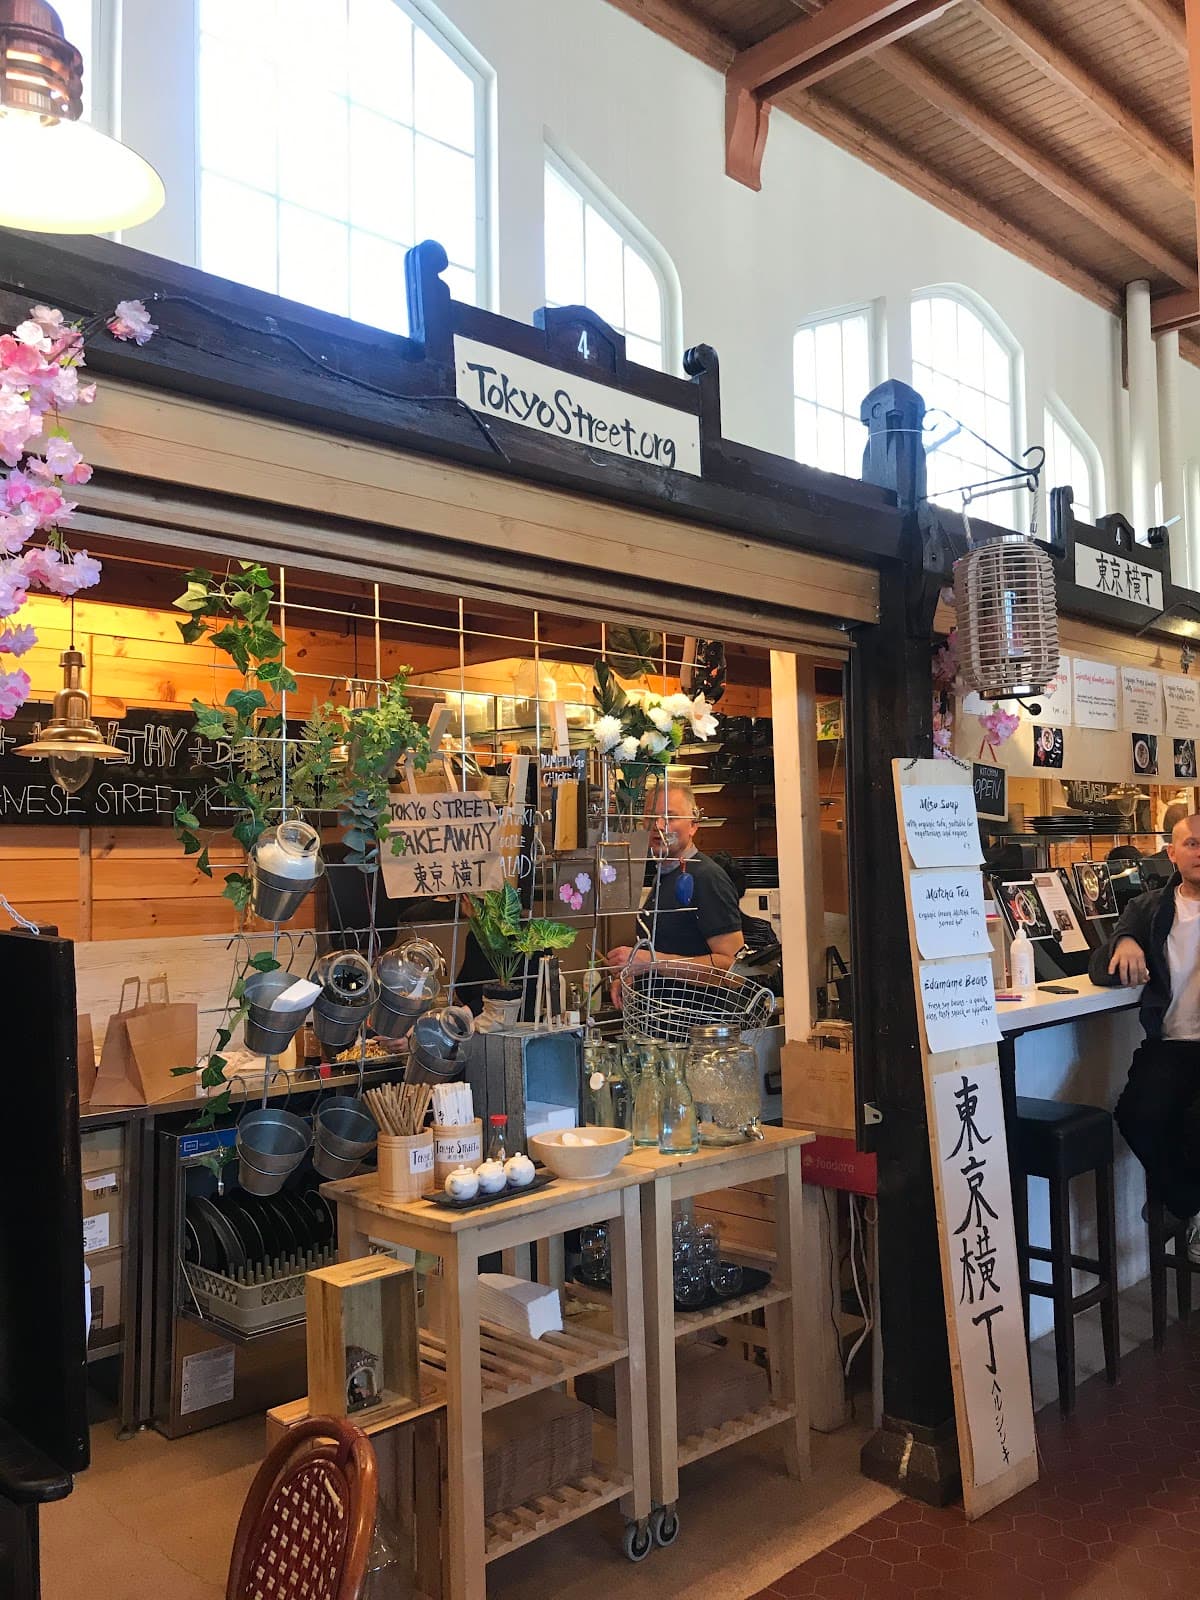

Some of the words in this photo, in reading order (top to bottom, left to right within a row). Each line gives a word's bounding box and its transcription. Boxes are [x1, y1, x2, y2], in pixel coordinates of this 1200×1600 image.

[577, 330, 590, 360] 4
[466, 361, 676, 468] TokyoStreet.org
[1096, 552, 1153, 605] 東京横丁
[96, 783, 192, 815] STREET
[975, 778, 1001, 800] OPEN
[432, 799, 493, 819] STREET
[920, 796, 938, 812] Miso
[940, 799, 959, 815] Soup
[926, 887, 954, 901] Matcha
[956, 885, 969, 898] Tea
[924, 977, 963, 993] Edamame
[965, 974, 988, 988] Beans
[816, 1157, 854, 1173] foodora
[945, 1075, 1004, 1374] 東京横丁
